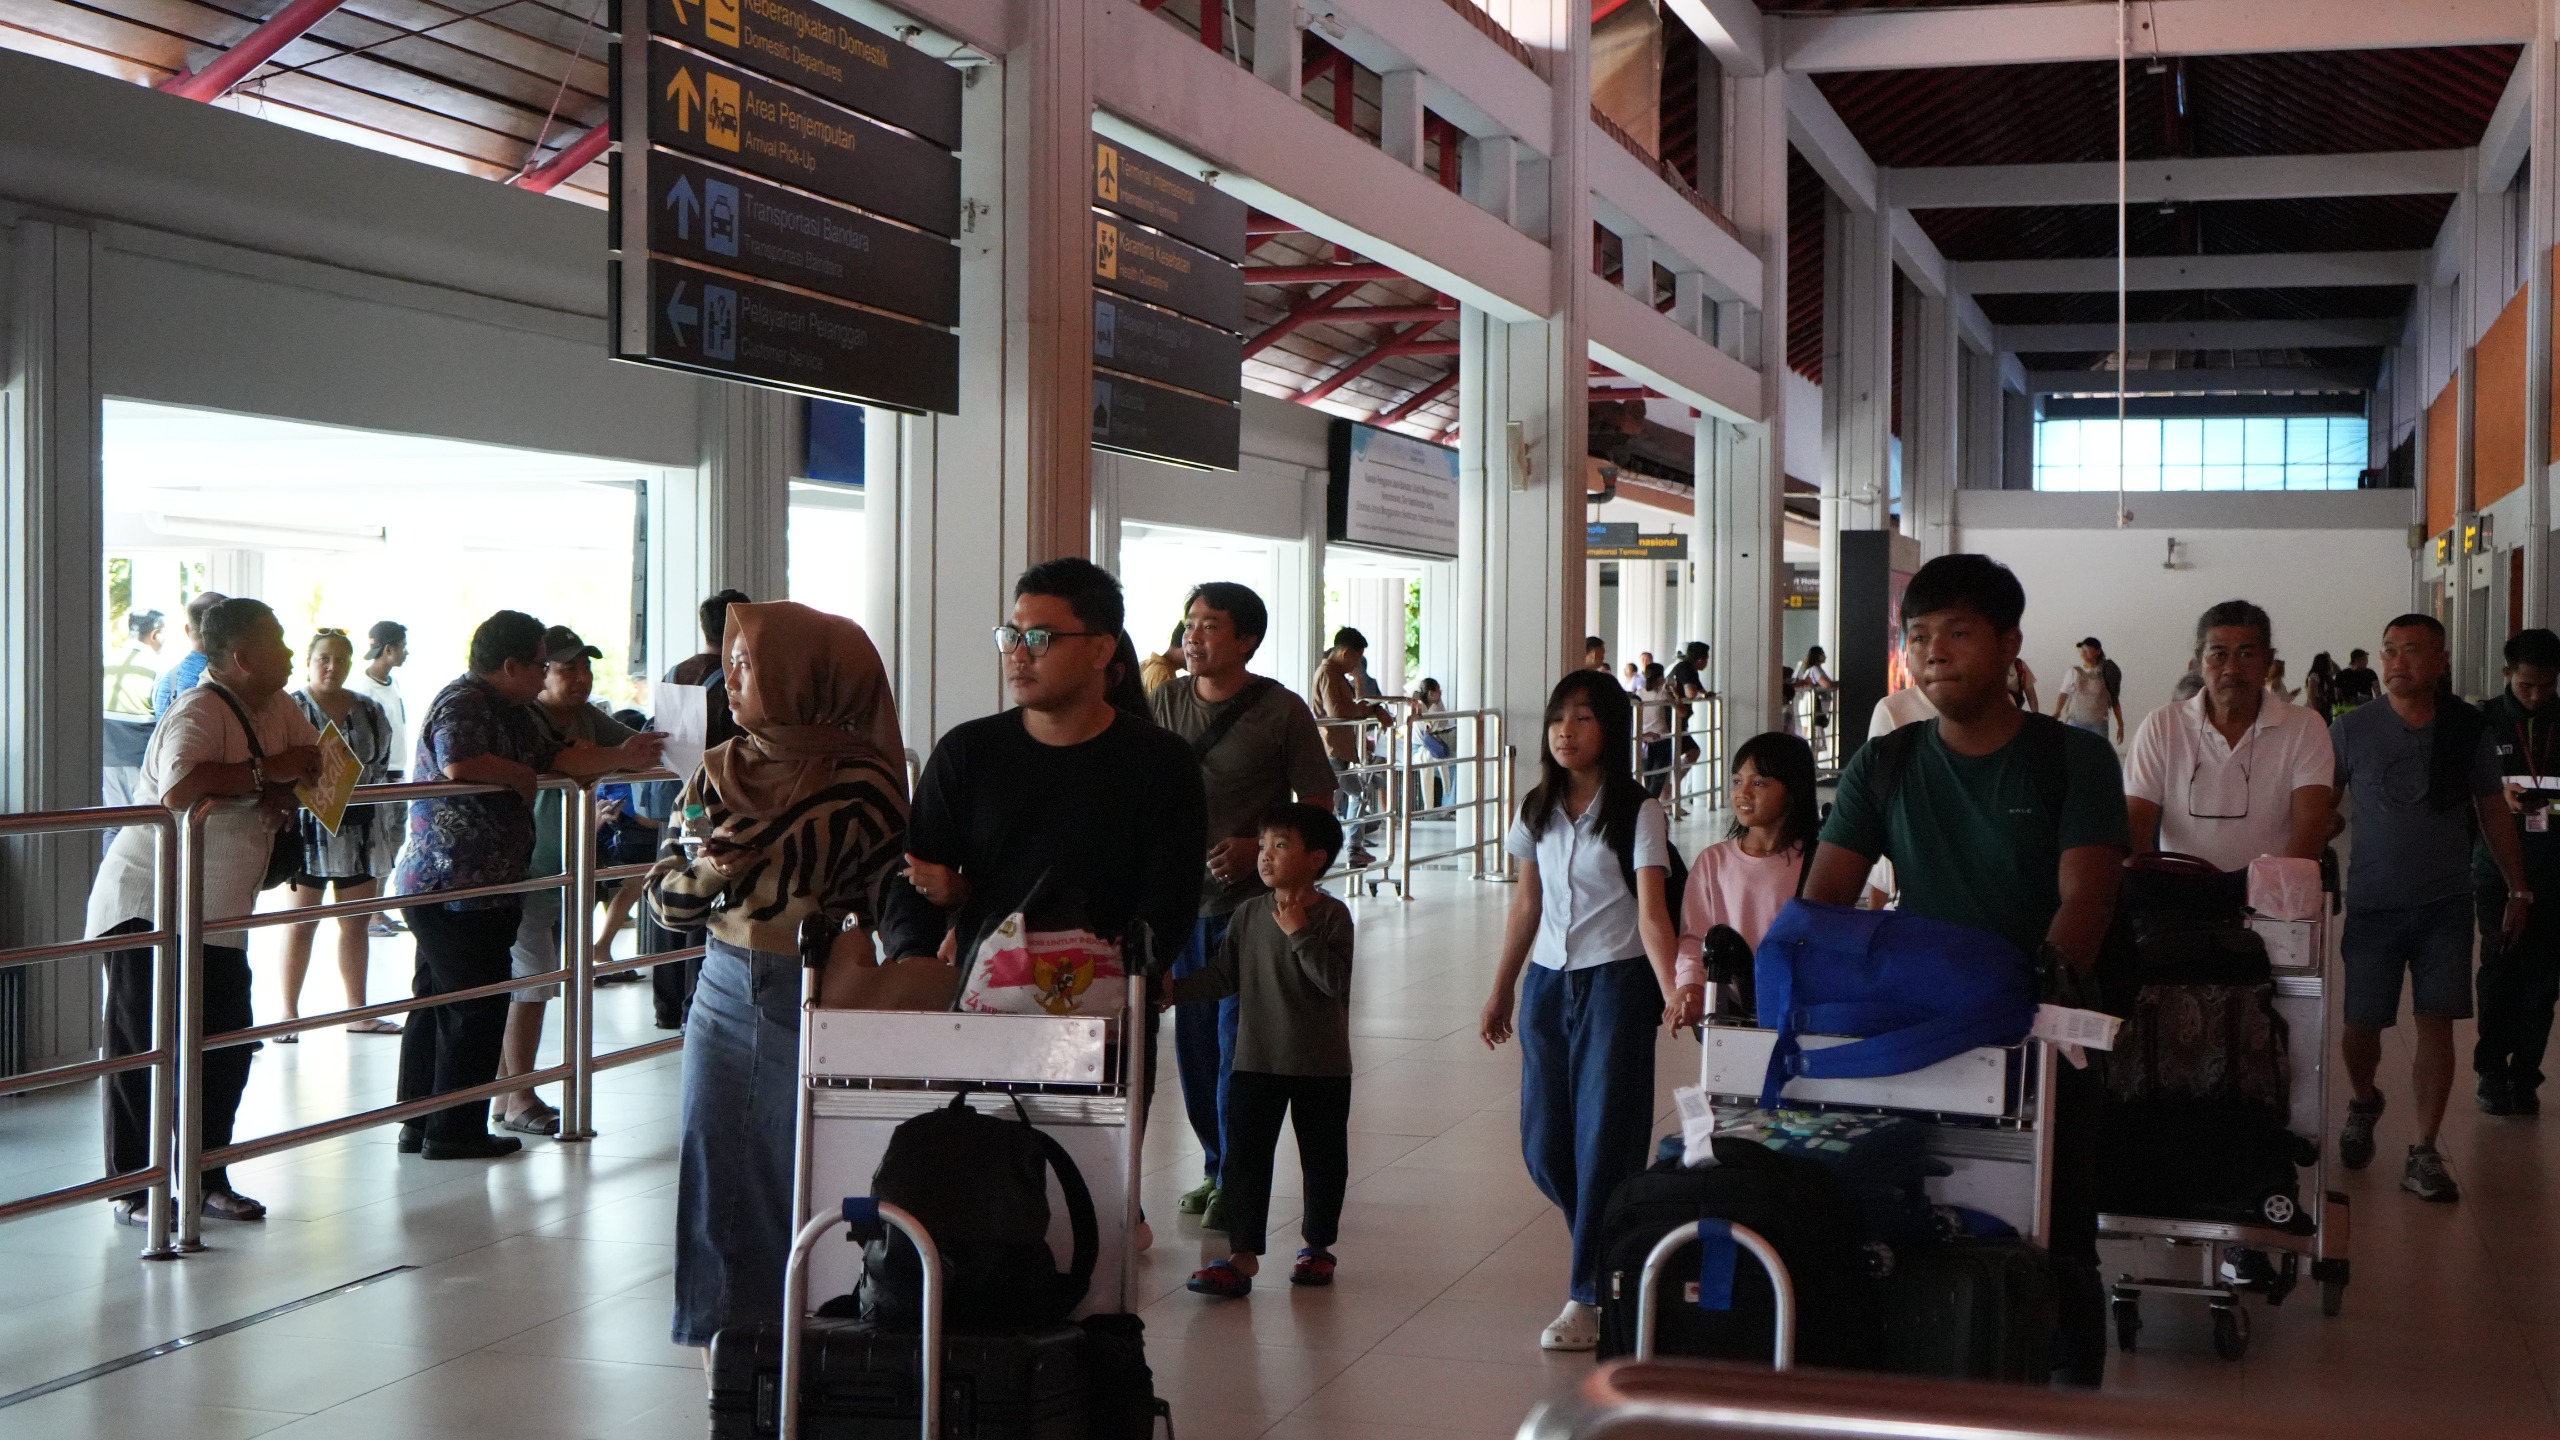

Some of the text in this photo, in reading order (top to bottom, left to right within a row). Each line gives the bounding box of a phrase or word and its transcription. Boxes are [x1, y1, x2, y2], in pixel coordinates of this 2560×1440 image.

[744, 25, 844, 83] Domestic Departures
[839, 26, 889, 70] Domestik
[745, 90, 856, 152] Area Penjemputan
[745, 130, 817, 174] Arrival Pick-Up
[743, 192, 870, 253] Transportasi Bandara
[740, 295, 868, 350] Pelayanan Pelanggan
